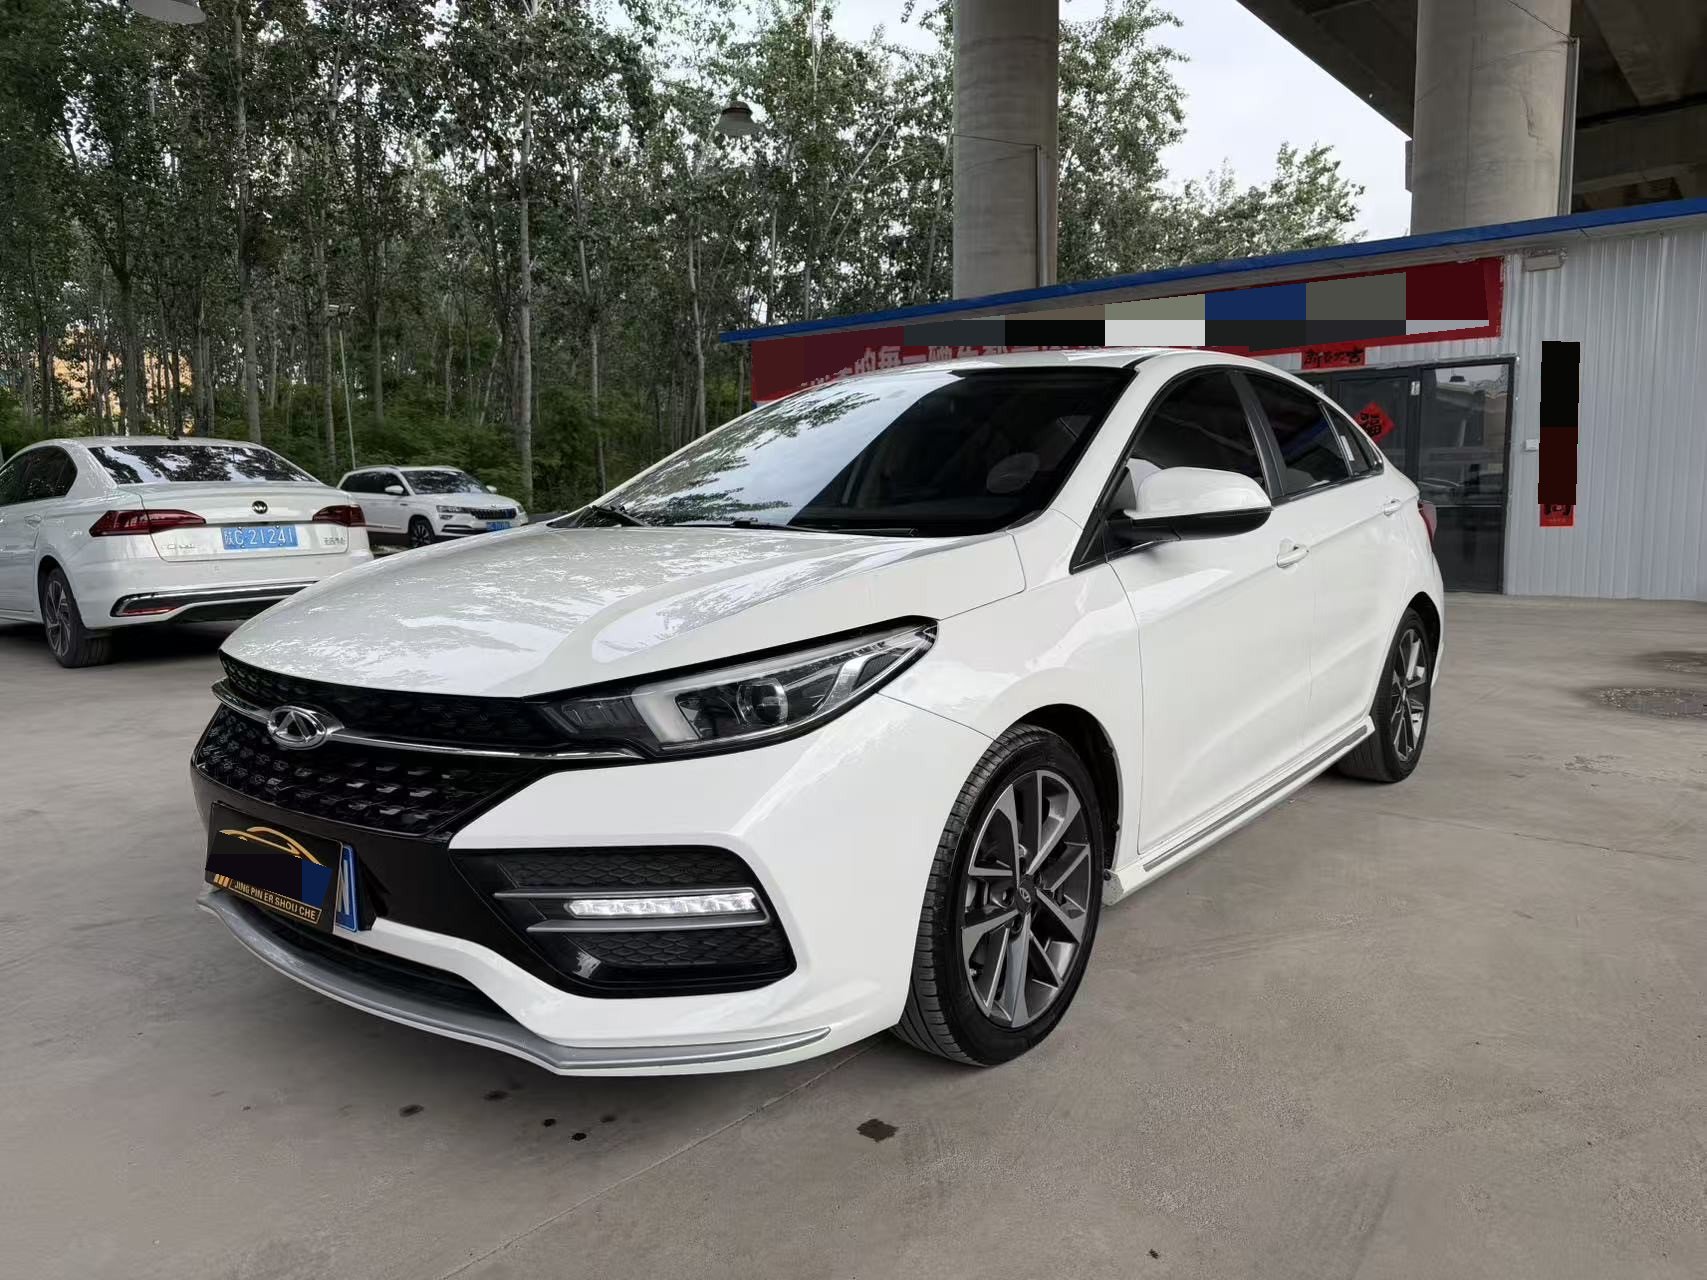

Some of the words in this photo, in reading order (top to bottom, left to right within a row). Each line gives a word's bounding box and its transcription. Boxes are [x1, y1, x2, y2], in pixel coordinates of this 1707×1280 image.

[1360, 412, 1382, 437] 福
[234, 881, 250, 894] JING
[250, 887, 263, 900] PIN
[264, 892, 274, 903] ER
[274, 896, 298, 912] SHOU
[299, 906, 317, 920] CHE
